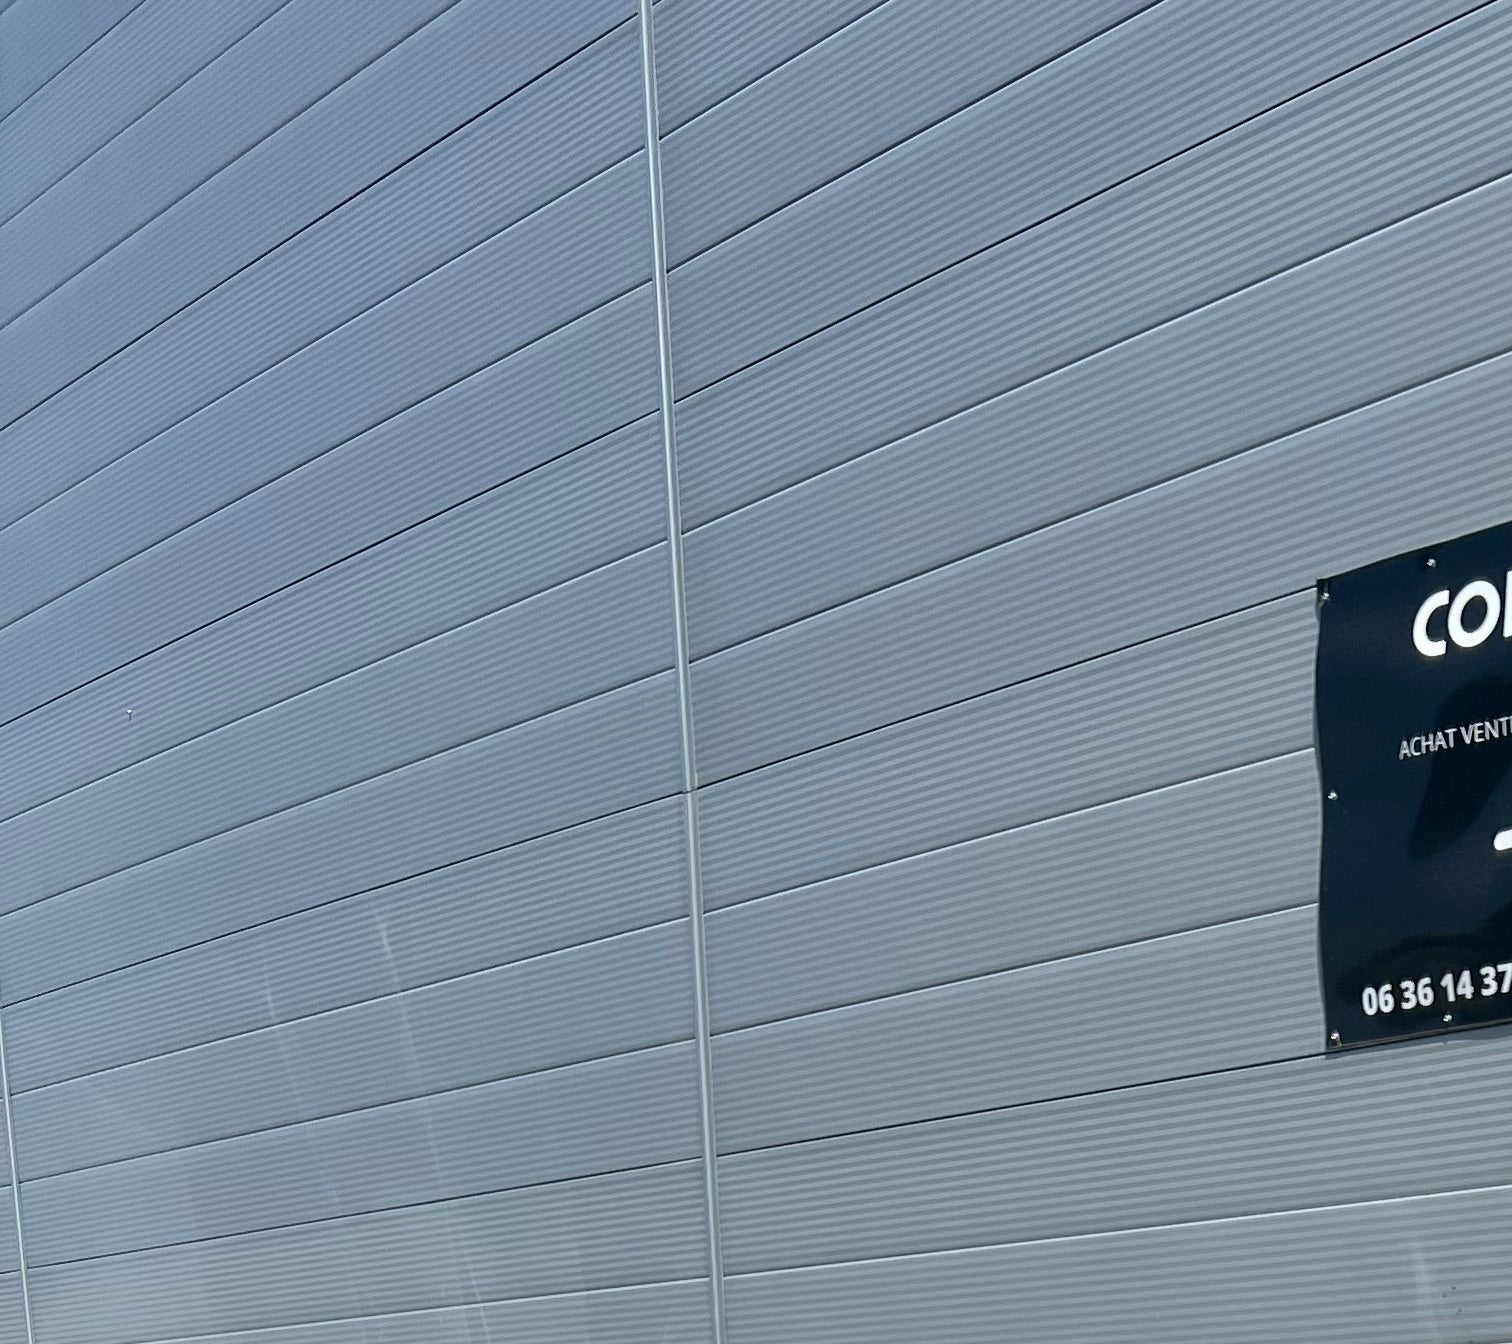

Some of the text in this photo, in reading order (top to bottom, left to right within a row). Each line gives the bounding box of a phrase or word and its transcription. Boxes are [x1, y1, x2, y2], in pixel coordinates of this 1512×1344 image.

[1398, 727, 1459, 760] ACHAT
[1361, 983, 1395, 1016] 06
[1399, 976, 1435, 1010] 36
[1439, 969, 1475, 1002] 14
